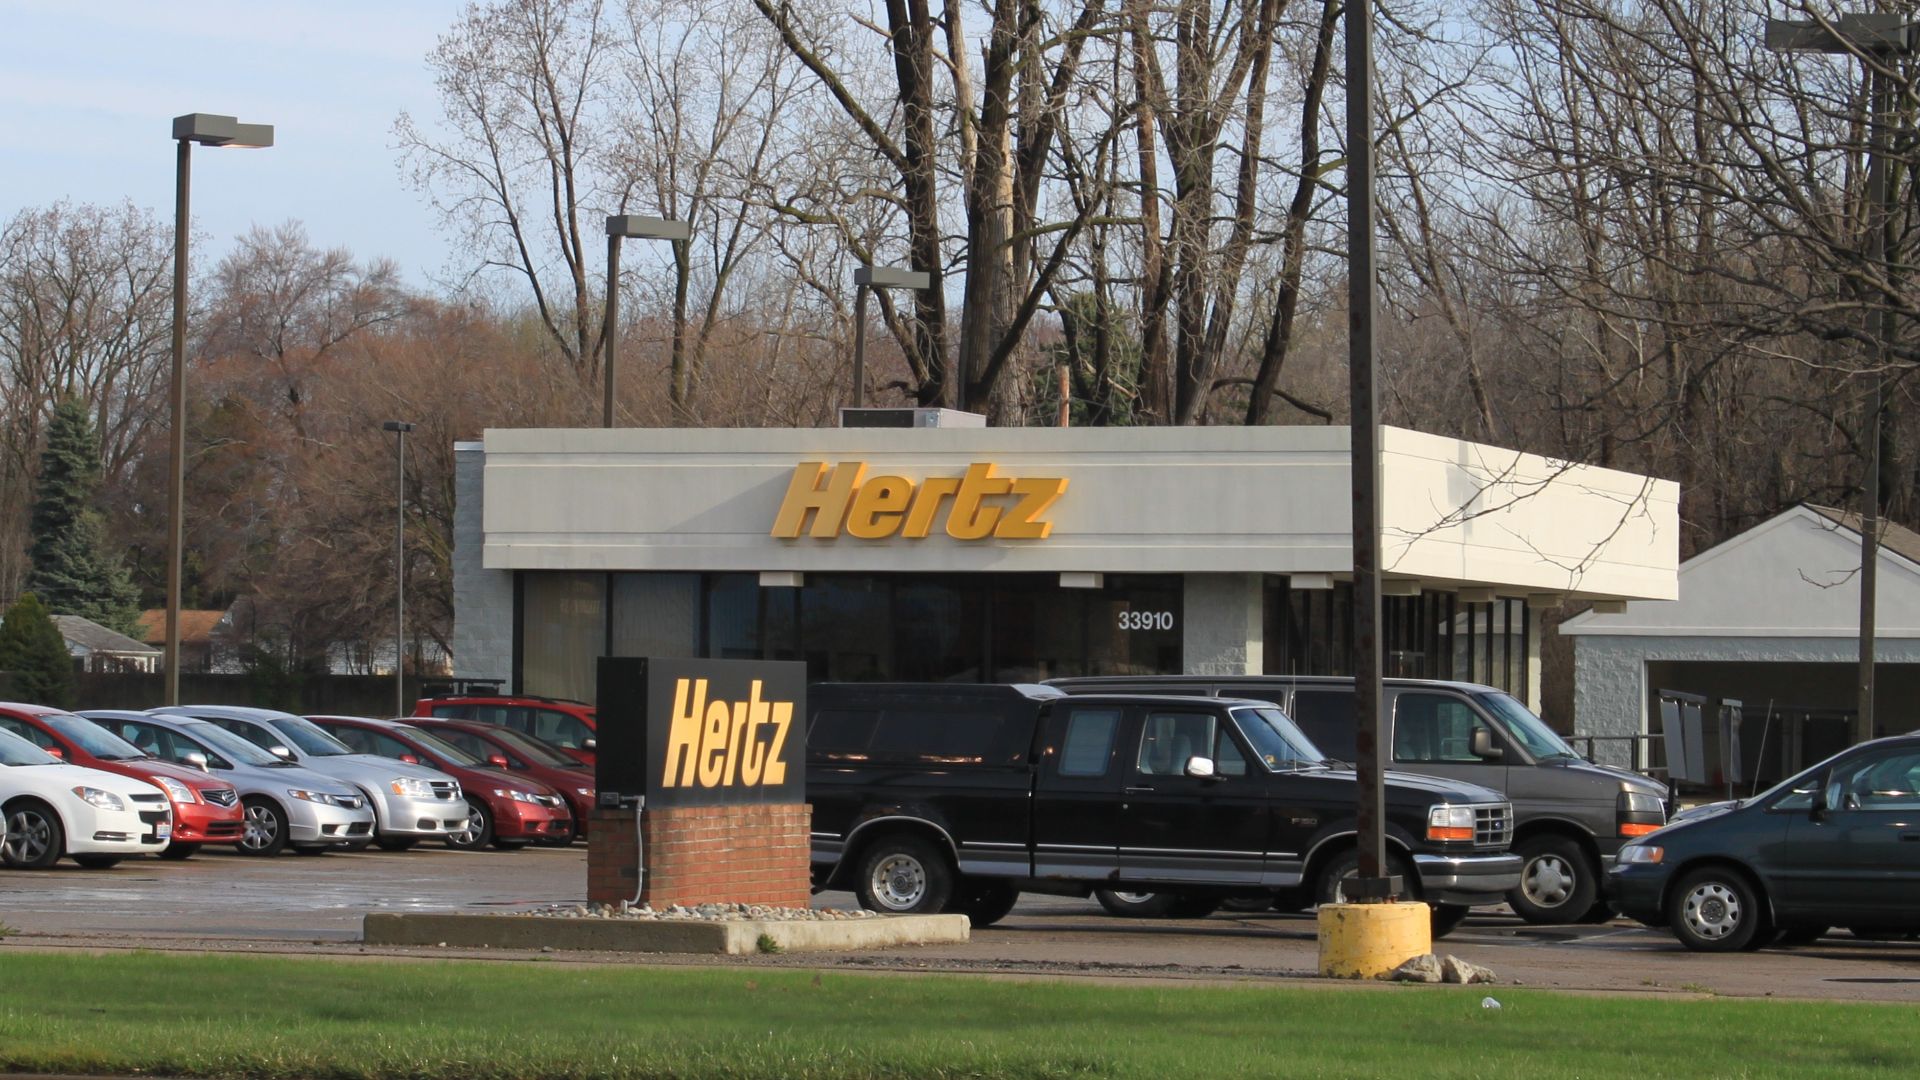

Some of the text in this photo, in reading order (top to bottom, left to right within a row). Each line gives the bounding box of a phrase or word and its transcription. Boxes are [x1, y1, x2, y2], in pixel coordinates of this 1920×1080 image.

[770, 461, 1070, 539] Hertz
[1118, 611, 1173, 630] 33910
[662, 678, 793, 788] Hertz
